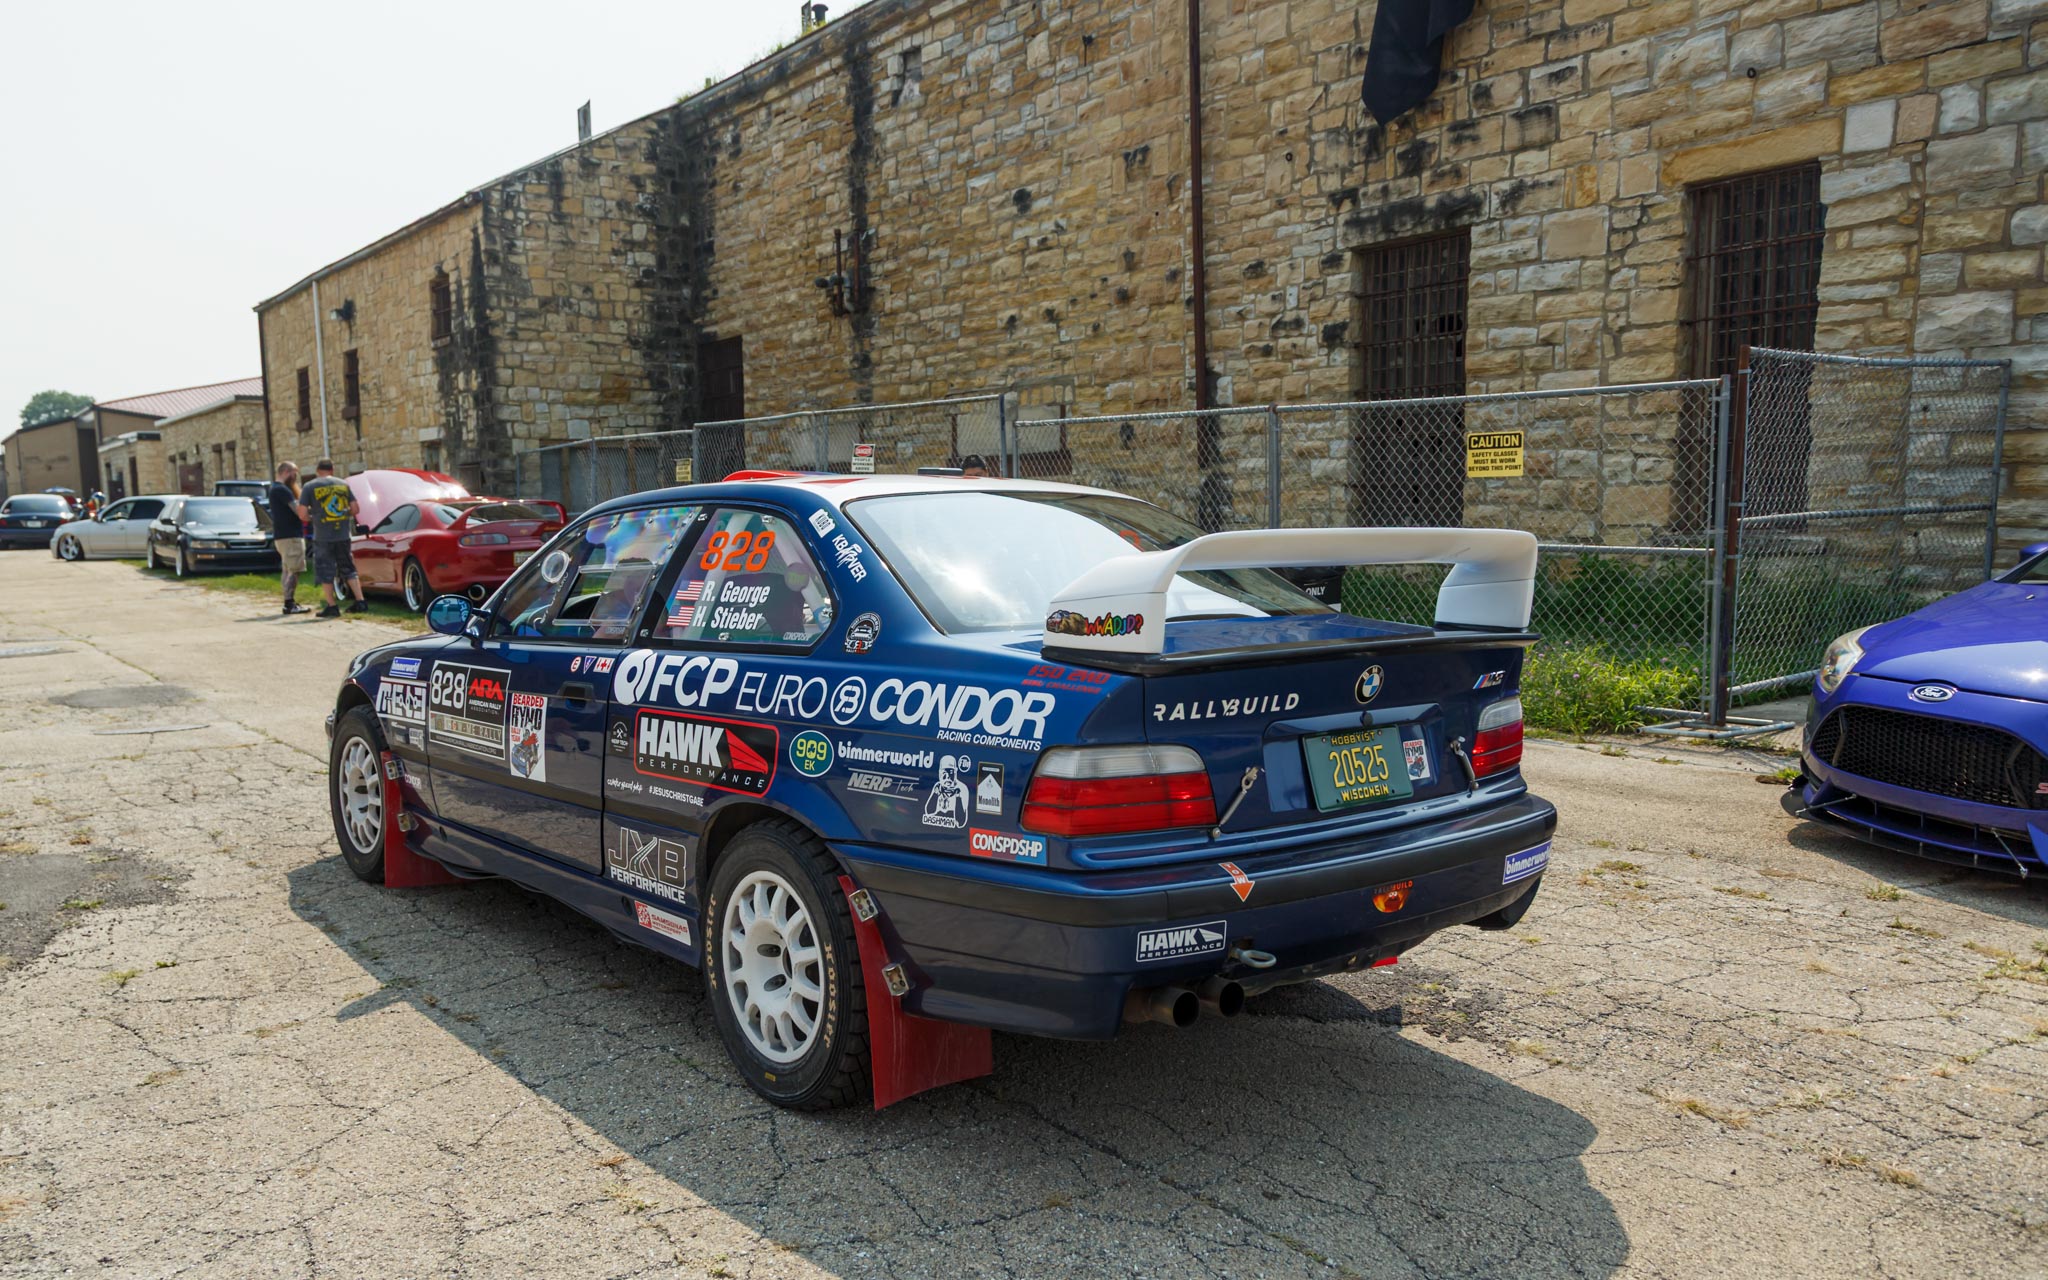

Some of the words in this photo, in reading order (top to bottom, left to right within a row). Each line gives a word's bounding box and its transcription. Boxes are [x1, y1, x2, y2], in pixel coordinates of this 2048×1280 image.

[1470, 434, 1519, 448] CAUTION
[700, 531, 776, 571] 828
[702, 580, 716, 602] R.
[720, 581, 770, 609] George
[1306, 586, 1326, 596] ONLY
[693, 606, 707, 627] H.
[711, 607, 762, 630] Stieber
[431, 669, 466, 709] 828
[468, 678, 504, 701] ARA
[649, 655, 739, 708] FCP
[736, 672, 827, 719] EURO
[869, 679, 1056, 739] CONDOR
[469, 699, 489, 707] AMERICAN
[490, 702, 502, 710] RALLY
[513, 694, 544, 708] BEARDED
[1153, 693, 1299, 721] RALLYBUILD
[638, 716, 725, 768] HAWK
[936, 729, 971, 744] RACING
[972, 734, 1042, 751] COMPONENTS
[1331, 732, 1375, 745] HOBBYIST
[804, 760, 815, 771] EK
[838, 741, 934, 769] bimmerworld
[1329, 745, 1389, 788] 20525
[639, 757, 764, 788] PERFORMANCE
[847, 772, 893, 791] NERP
[1341, 785, 1389, 801] WISCONSIN
[923, 816, 955, 827] DASHMAN
[972, 833, 1043, 857] CONSPDSHP
[610, 866, 686, 904] PERFORMANCE
[1139, 929, 1198, 952] HAWK
[1139, 942, 1222, 958] PERFORMANCE
[824, 940, 837, 1049] Hoosier
